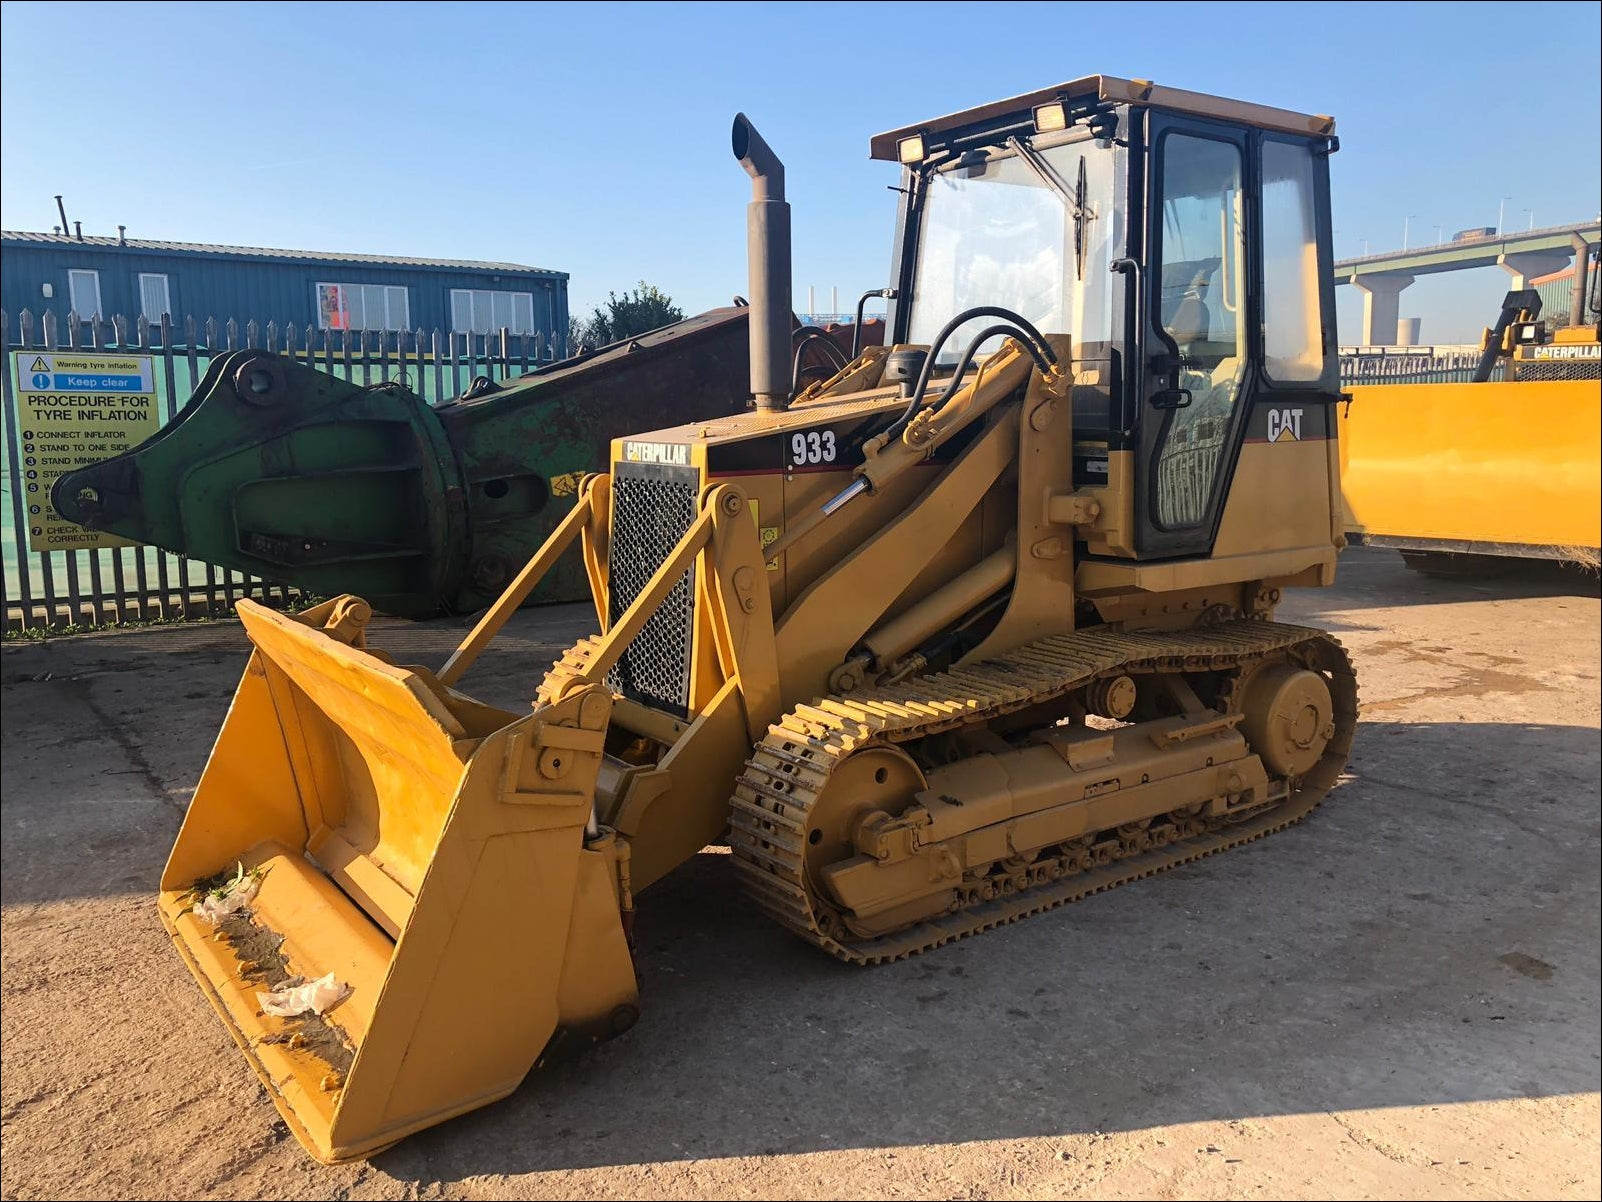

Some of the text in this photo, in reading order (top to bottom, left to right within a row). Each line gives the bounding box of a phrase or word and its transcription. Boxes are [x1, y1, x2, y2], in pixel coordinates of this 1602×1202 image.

[56, 361, 137, 370] Warning tyre inflation
[68, 377, 128, 388] Keep clear
[28, 396, 149, 407] PROCEDURE FOR
[33, 410, 148, 421] TYRE INFLATION
[1268, 409, 1303, 442] CAT
[626, 442, 687, 464] CATERPILLAR
[792, 430, 836, 465] 933
[47, 526, 78, 534] CHECK
[48, 534, 99, 543] CORRECTLY
